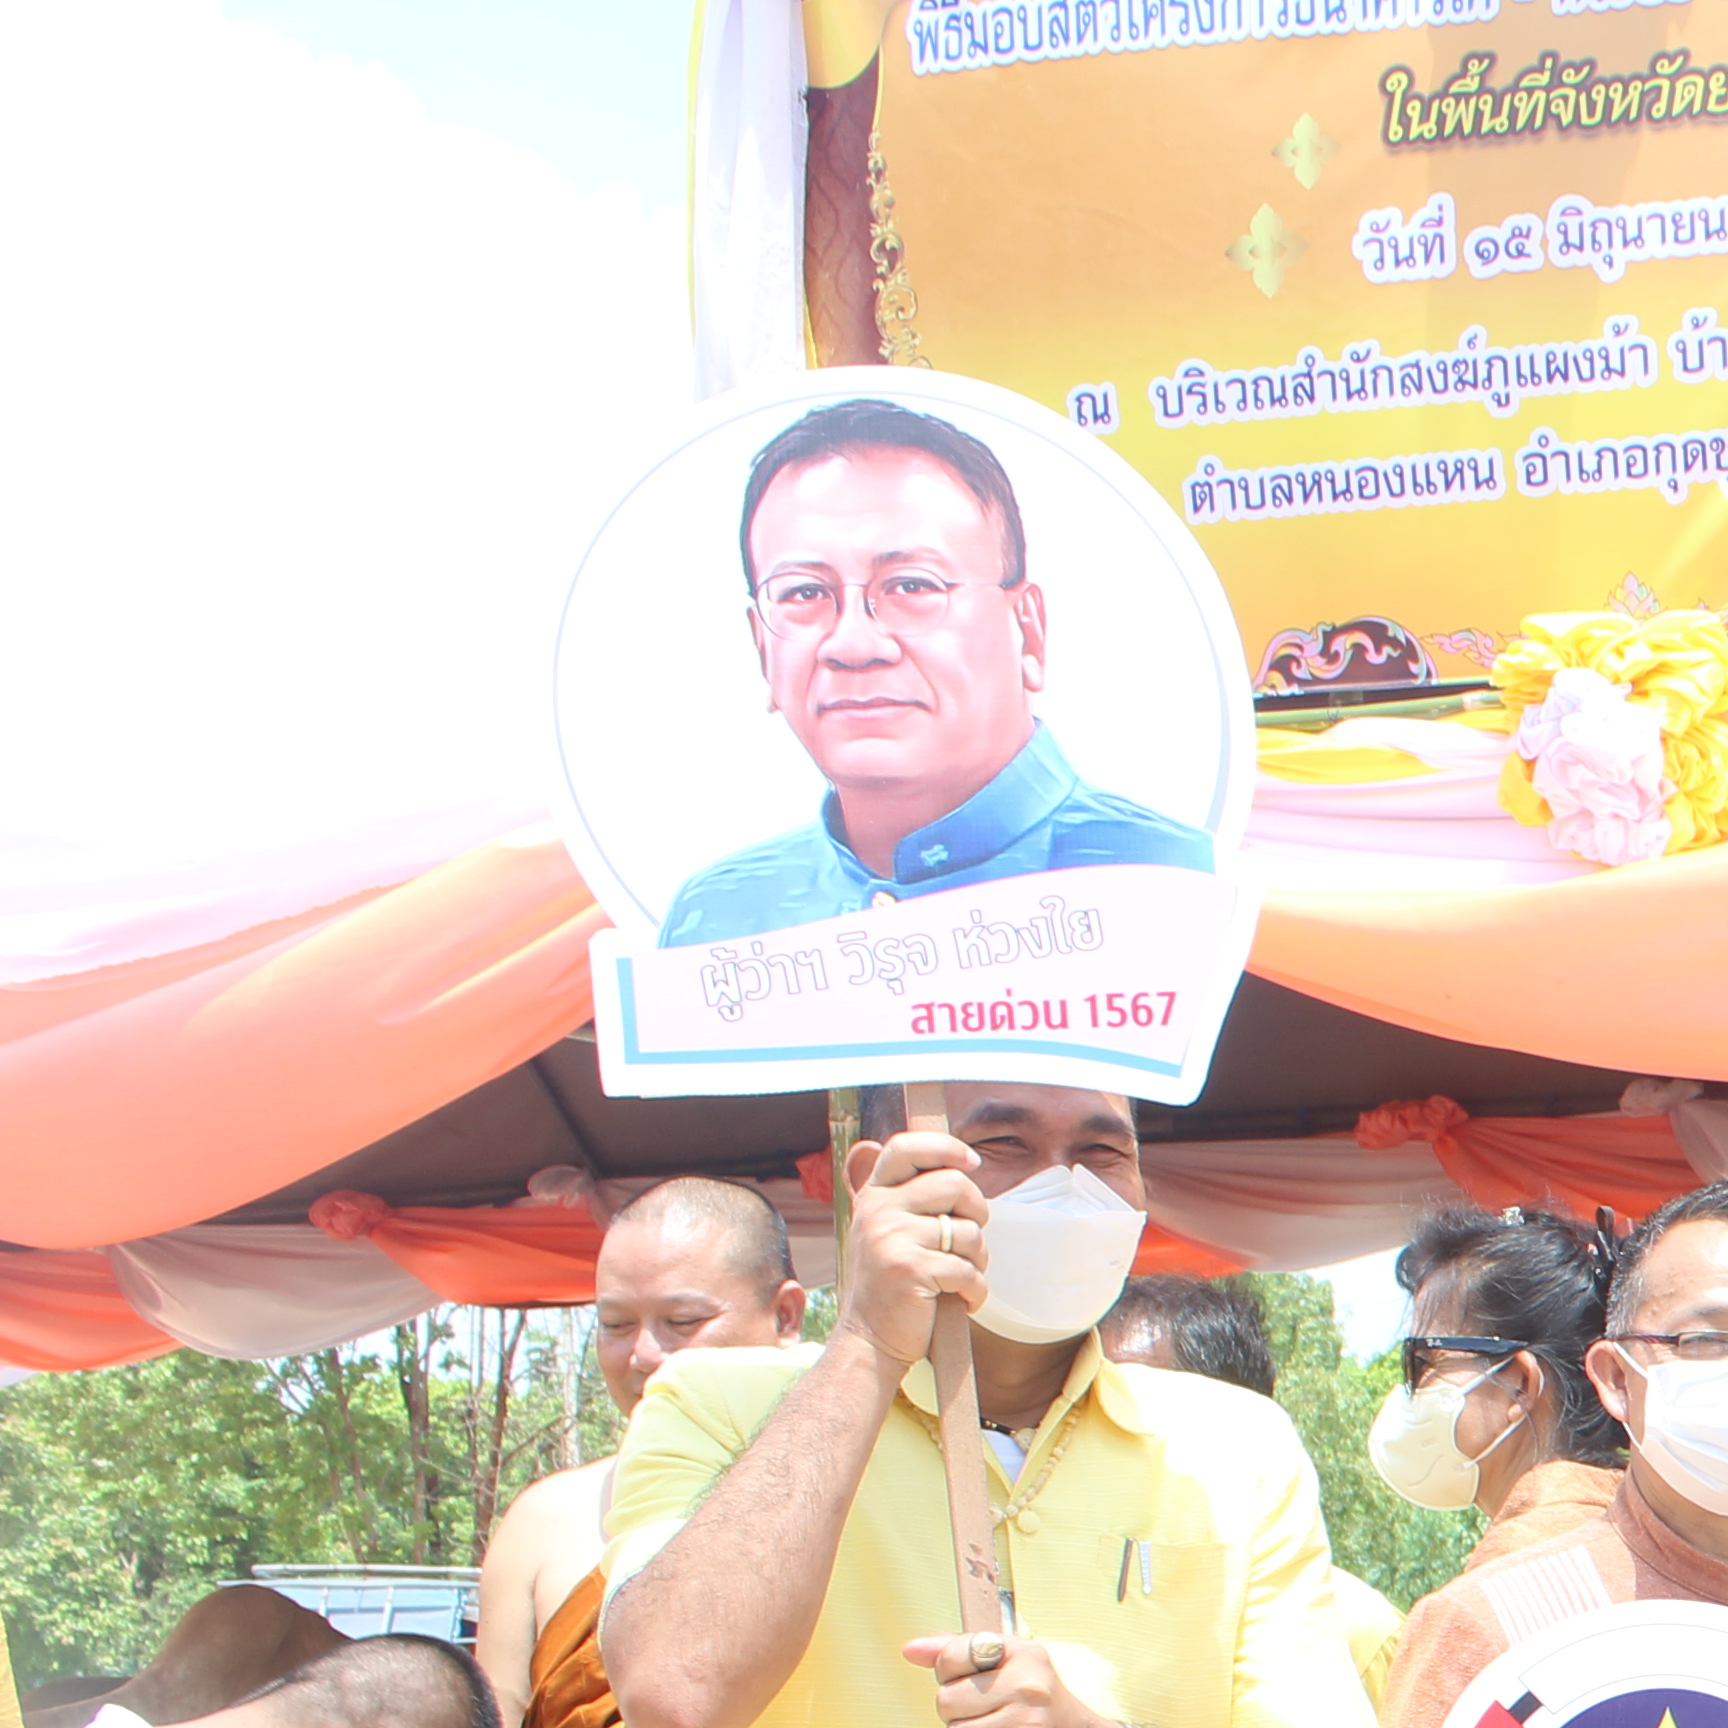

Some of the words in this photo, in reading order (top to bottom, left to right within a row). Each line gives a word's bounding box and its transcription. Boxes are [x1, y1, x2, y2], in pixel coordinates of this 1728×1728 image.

[1362, 203, 1447, 273] วันที่
[1473, 228, 1534, 267] ๑๕
[1556, 202, 1728, 270] มิถุนายน
[1074, 390, 1112, 426] ณ
[1156, 325, 1652, 420] บริเวณสำนักสงฆ์ภูแผงม้า
[1188, 449, 1496, 516] ตำบลหนองแหน
[700, 942, 830, 1023] ผู้ว่าฯ
[837, 930, 940, 997] วิรุจ
[952, 895, 1105, 970] ห่วงใย
[910, 988, 1069, 1034] สายด่วน
[1083, 992, 1178, 1030] 1567
